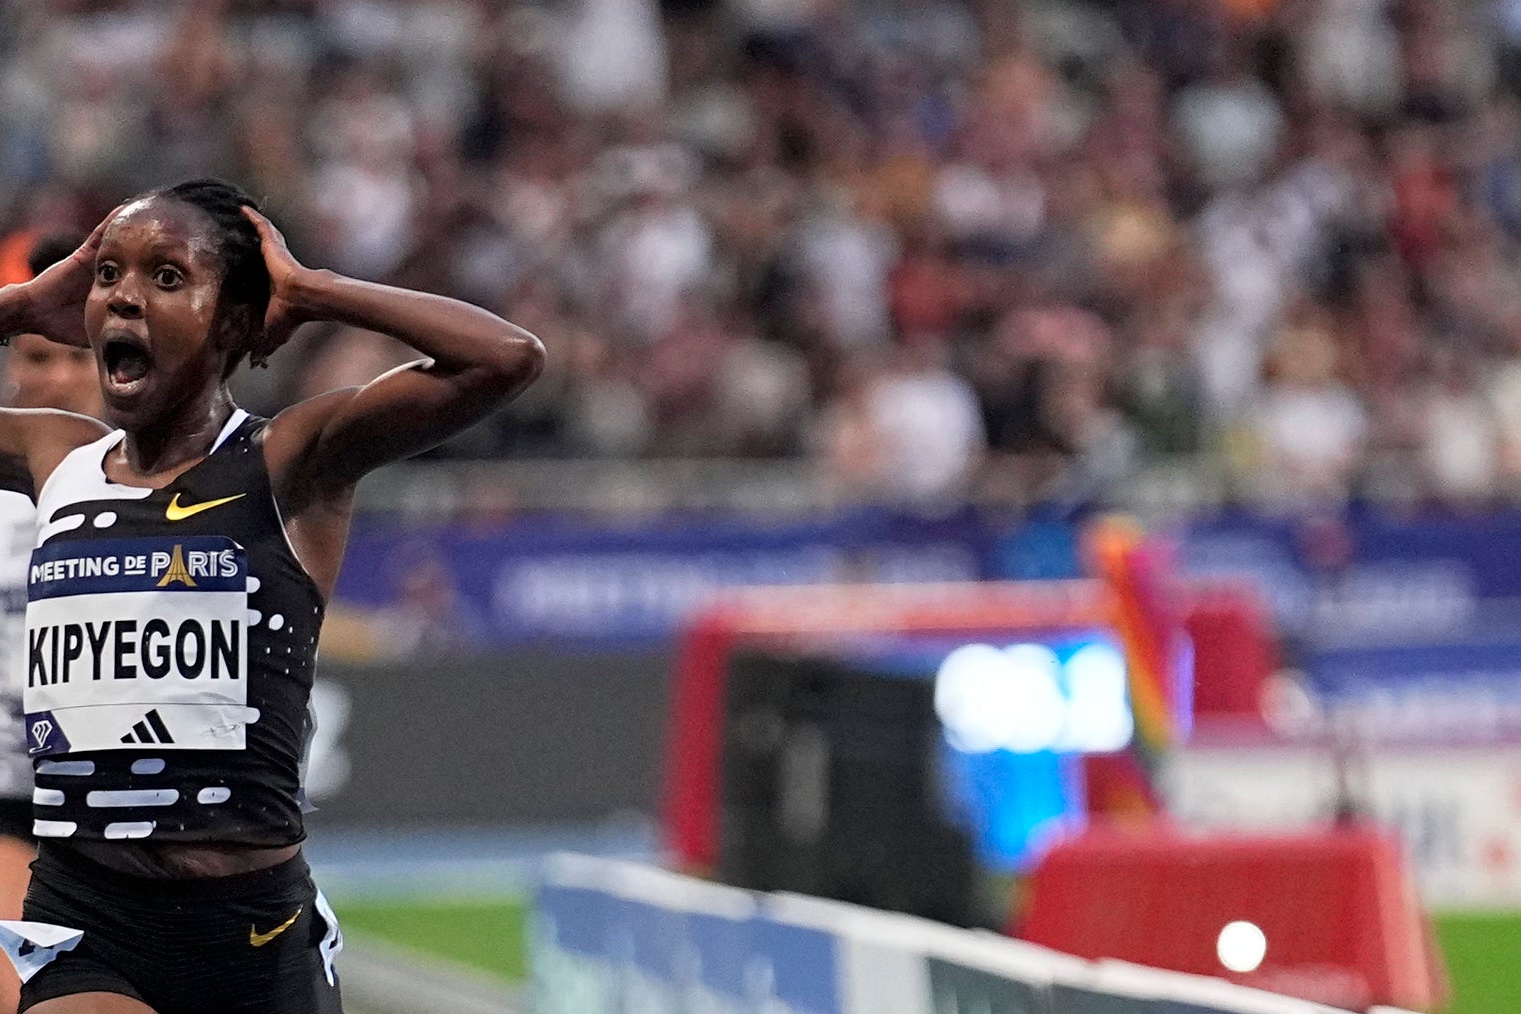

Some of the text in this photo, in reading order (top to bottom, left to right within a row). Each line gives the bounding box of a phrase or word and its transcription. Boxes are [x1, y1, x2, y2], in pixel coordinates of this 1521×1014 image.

[30, 544, 239, 588] MEETING DE PARIS
[28, 618, 240, 688] KIPYEGON
